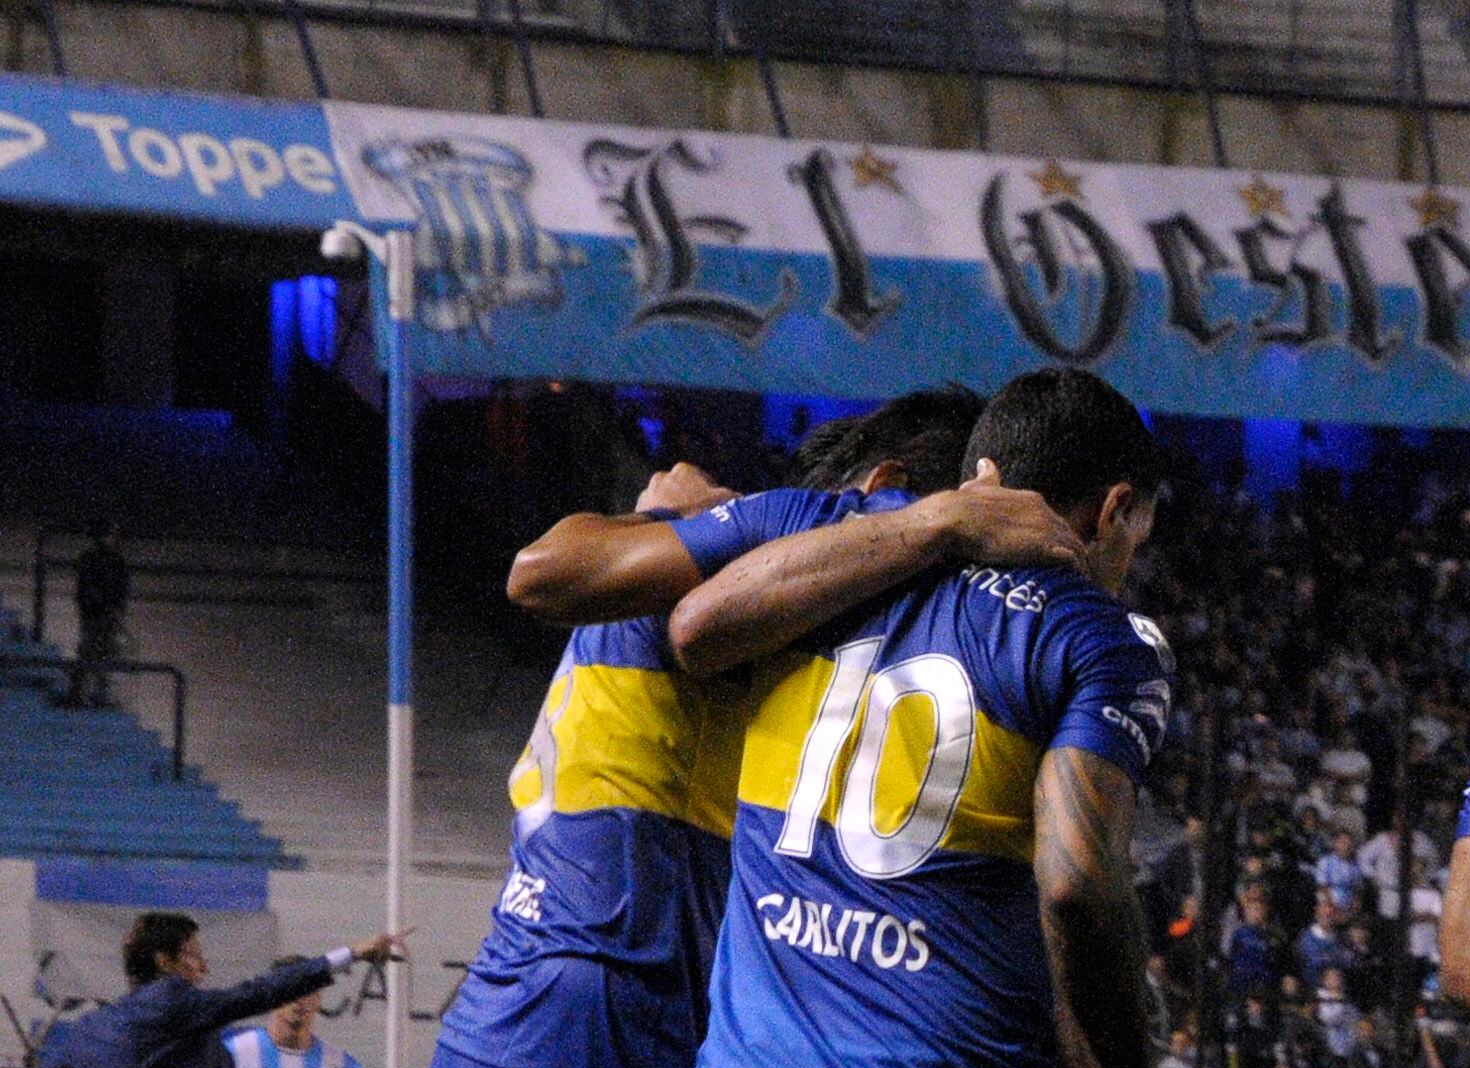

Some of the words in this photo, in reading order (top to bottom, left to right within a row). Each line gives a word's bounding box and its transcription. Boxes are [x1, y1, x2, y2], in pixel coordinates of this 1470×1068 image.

[69, 110, 338, 199] Toppe
[775, 635, 975, 879] 10
[756, 892, 930, 973] CARLITOS
